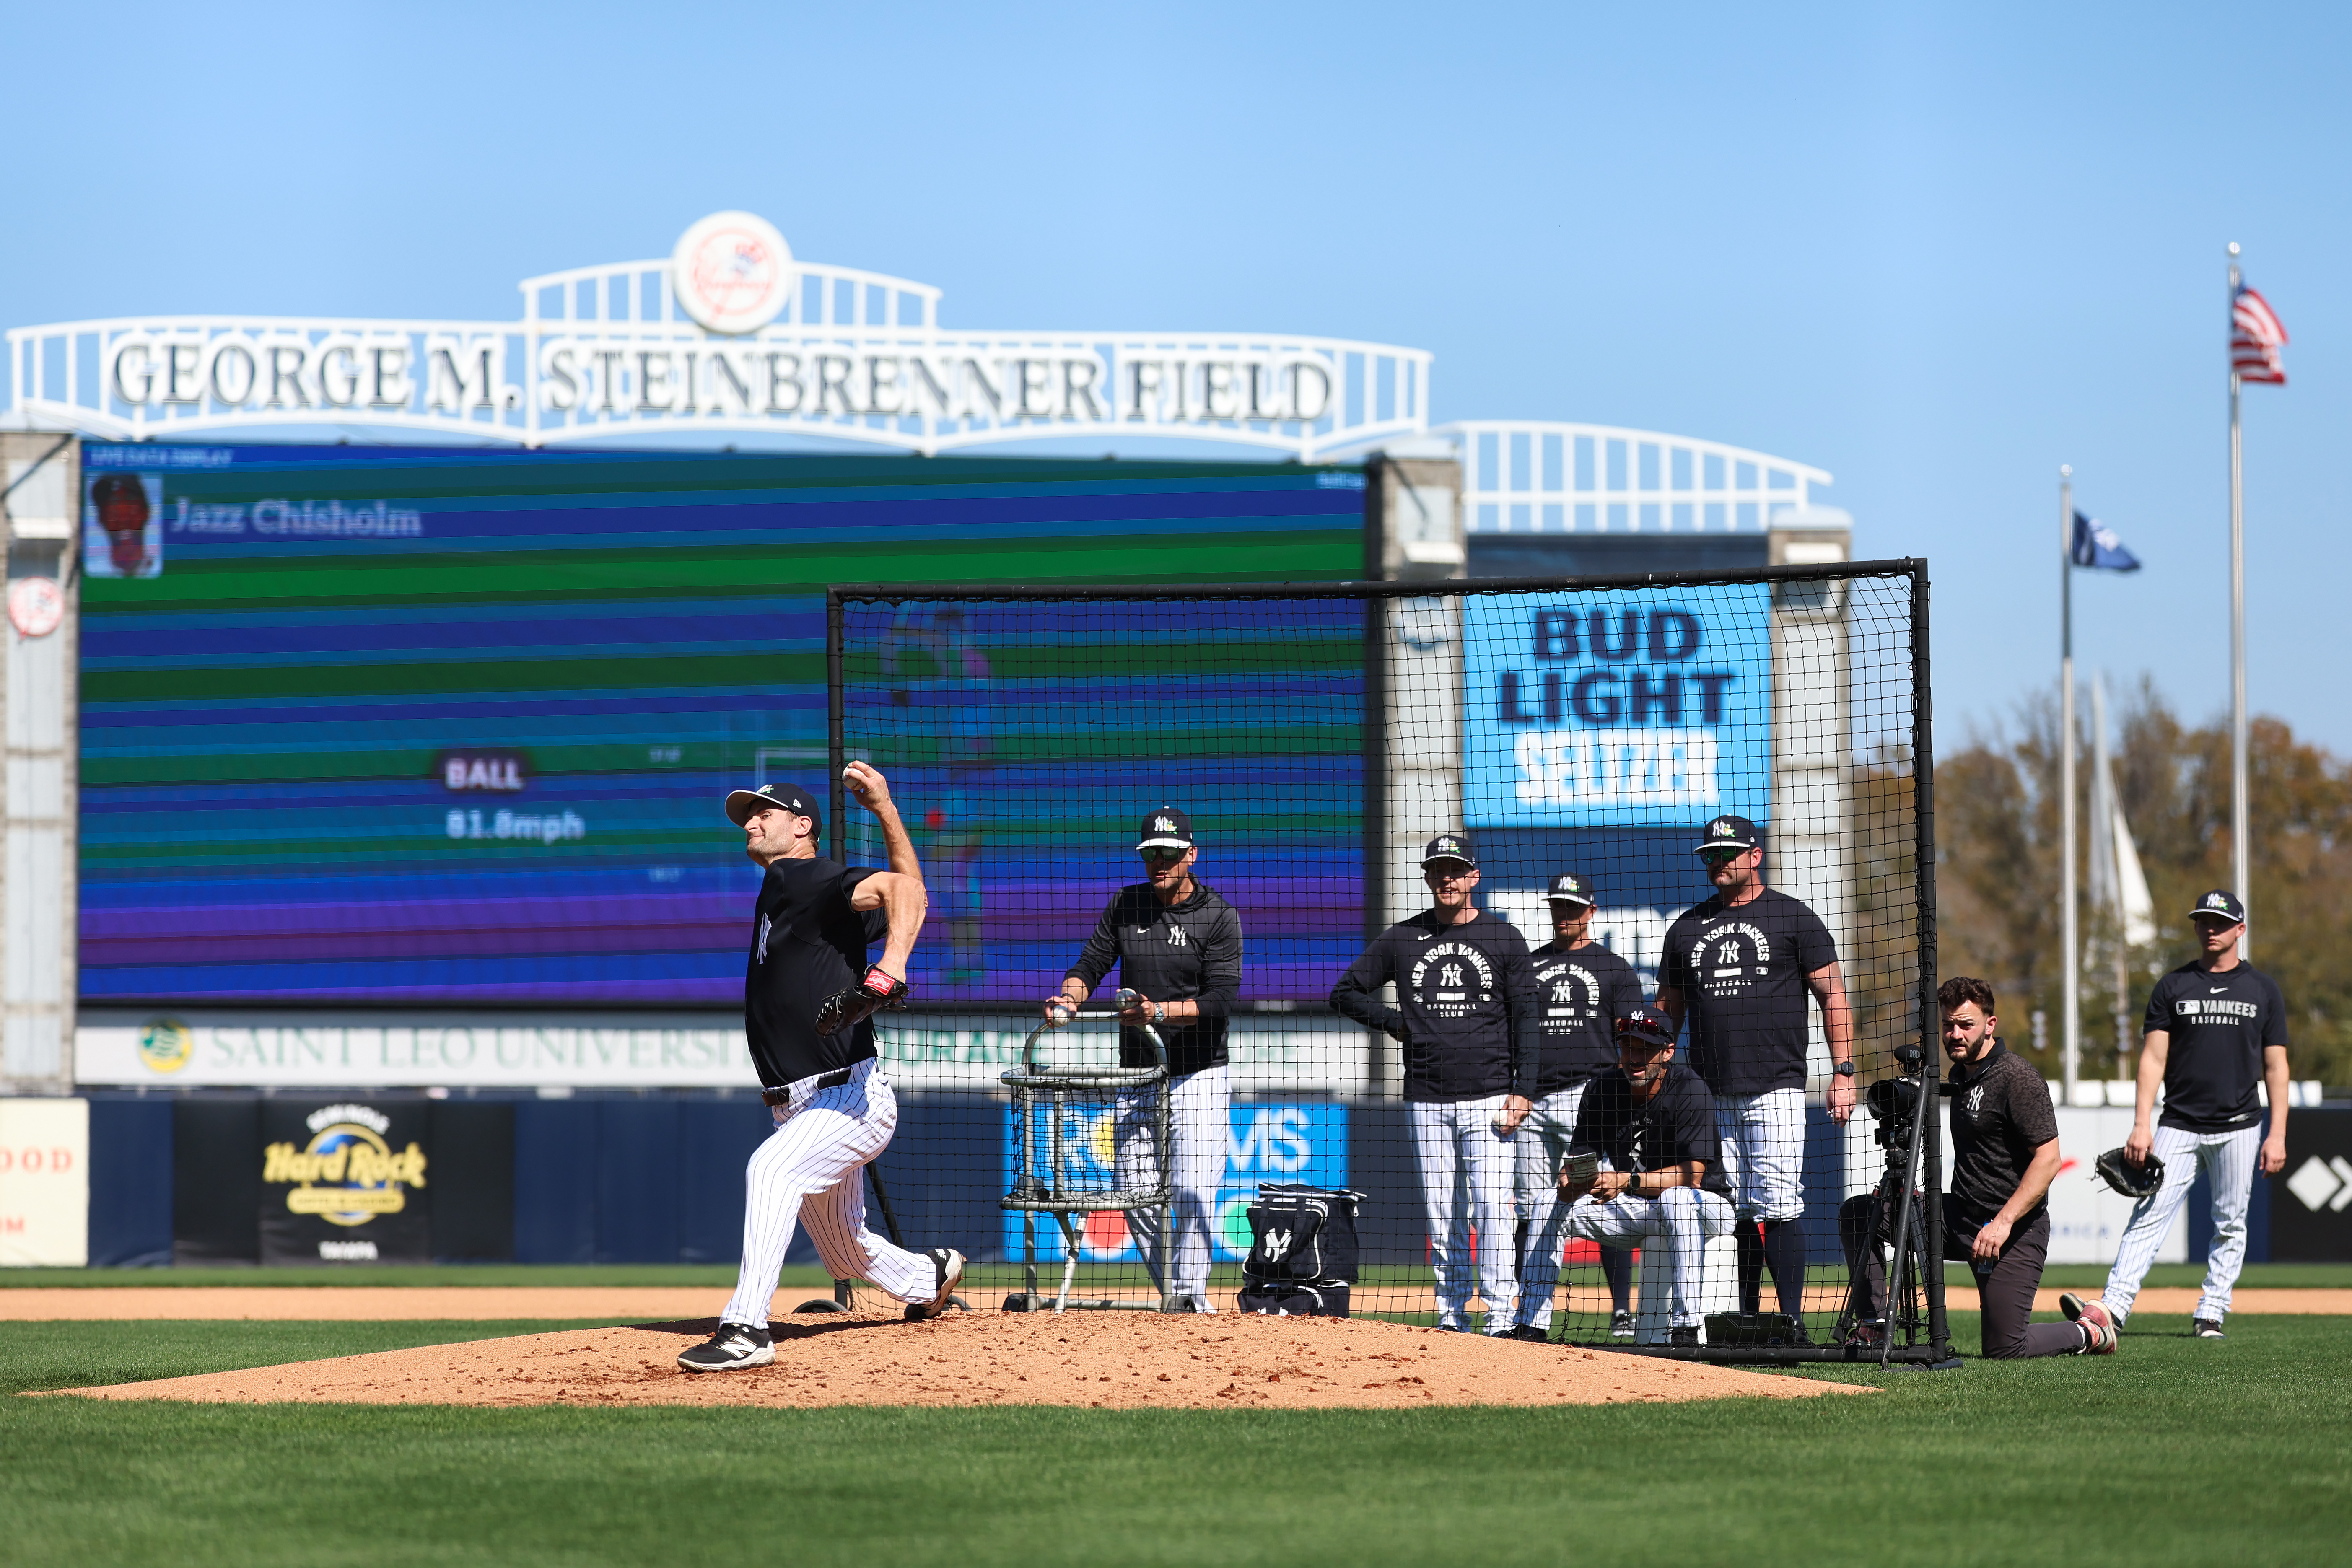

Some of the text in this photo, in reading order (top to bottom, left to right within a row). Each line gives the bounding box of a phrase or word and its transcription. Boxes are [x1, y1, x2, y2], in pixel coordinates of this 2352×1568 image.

[112, 345, 1332, 420] GEORGE M. STEINBRENNER FIELD
[170, 496, 422, 537] Jazz Chisholm
[1533, 609, 1700, 661] BUD
[1500, 671, 1737, 724] LIGHT
[444, 757, 526, 790] BALL
[1514, 729, 1720, 806] SELTZER
[1168, 925, 1187, 947] NY
[1691, 941, 1706, 968] NEW
[1703, 923, 1735, 942] YORK
[1738, 923, 1770, 961] YANKEES
[1718, 940, 1740, 964] NY
[1411, 943, 1493, 989] NEW YORK YANKEES
[1440, 963, 1463, 987] NY
[1569, 964, 1600, 1006] YANKEES
[1551, 980, 1573, 1003] NY
[2202, 999, 2258, 1018] YANKEES
[2191, 1016, 2240, 1026] BASEBALL
[210, 1026, 358, 1069] SAINT
[379, 1026, 476, 1069] LEO
[1967, 1086, 1984, 1112] NY
[262, 1142, 427, 1189] Hard Rock
[1264, 1228, 1293, 1263] NY
